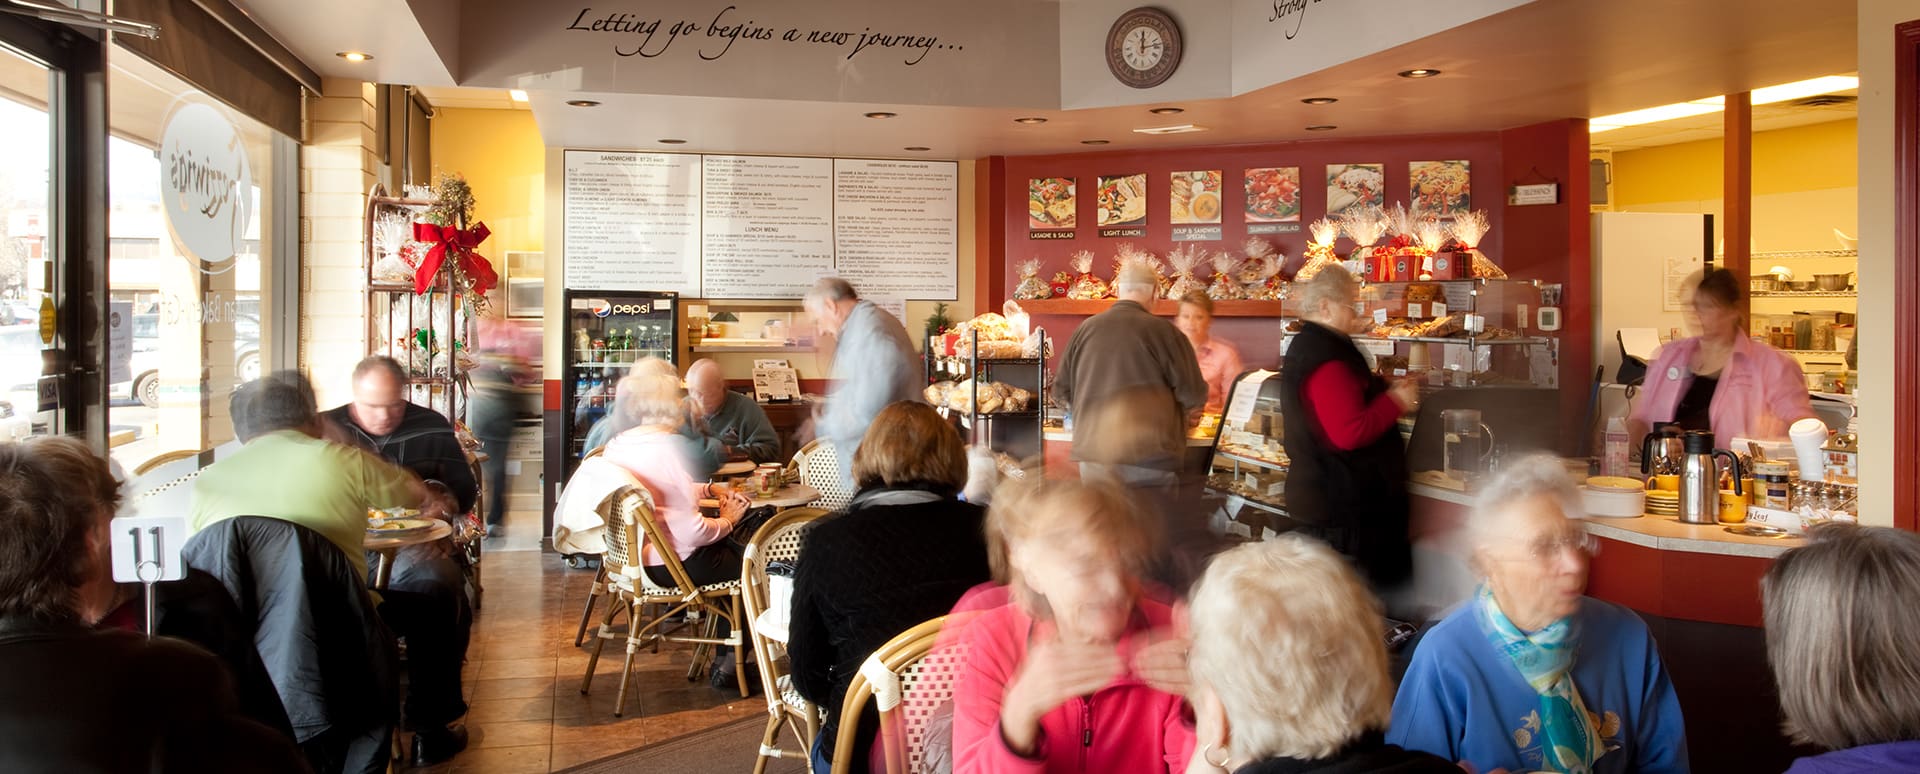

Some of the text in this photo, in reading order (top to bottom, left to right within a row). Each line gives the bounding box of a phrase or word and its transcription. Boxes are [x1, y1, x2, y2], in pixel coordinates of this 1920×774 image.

[566, 6, 963, 65] Letting go begins a new journey...
[613, 303, 650, 315] pepsi
[42, 382, 57, 400] VISA
[128, 526, 162, 568] 11
